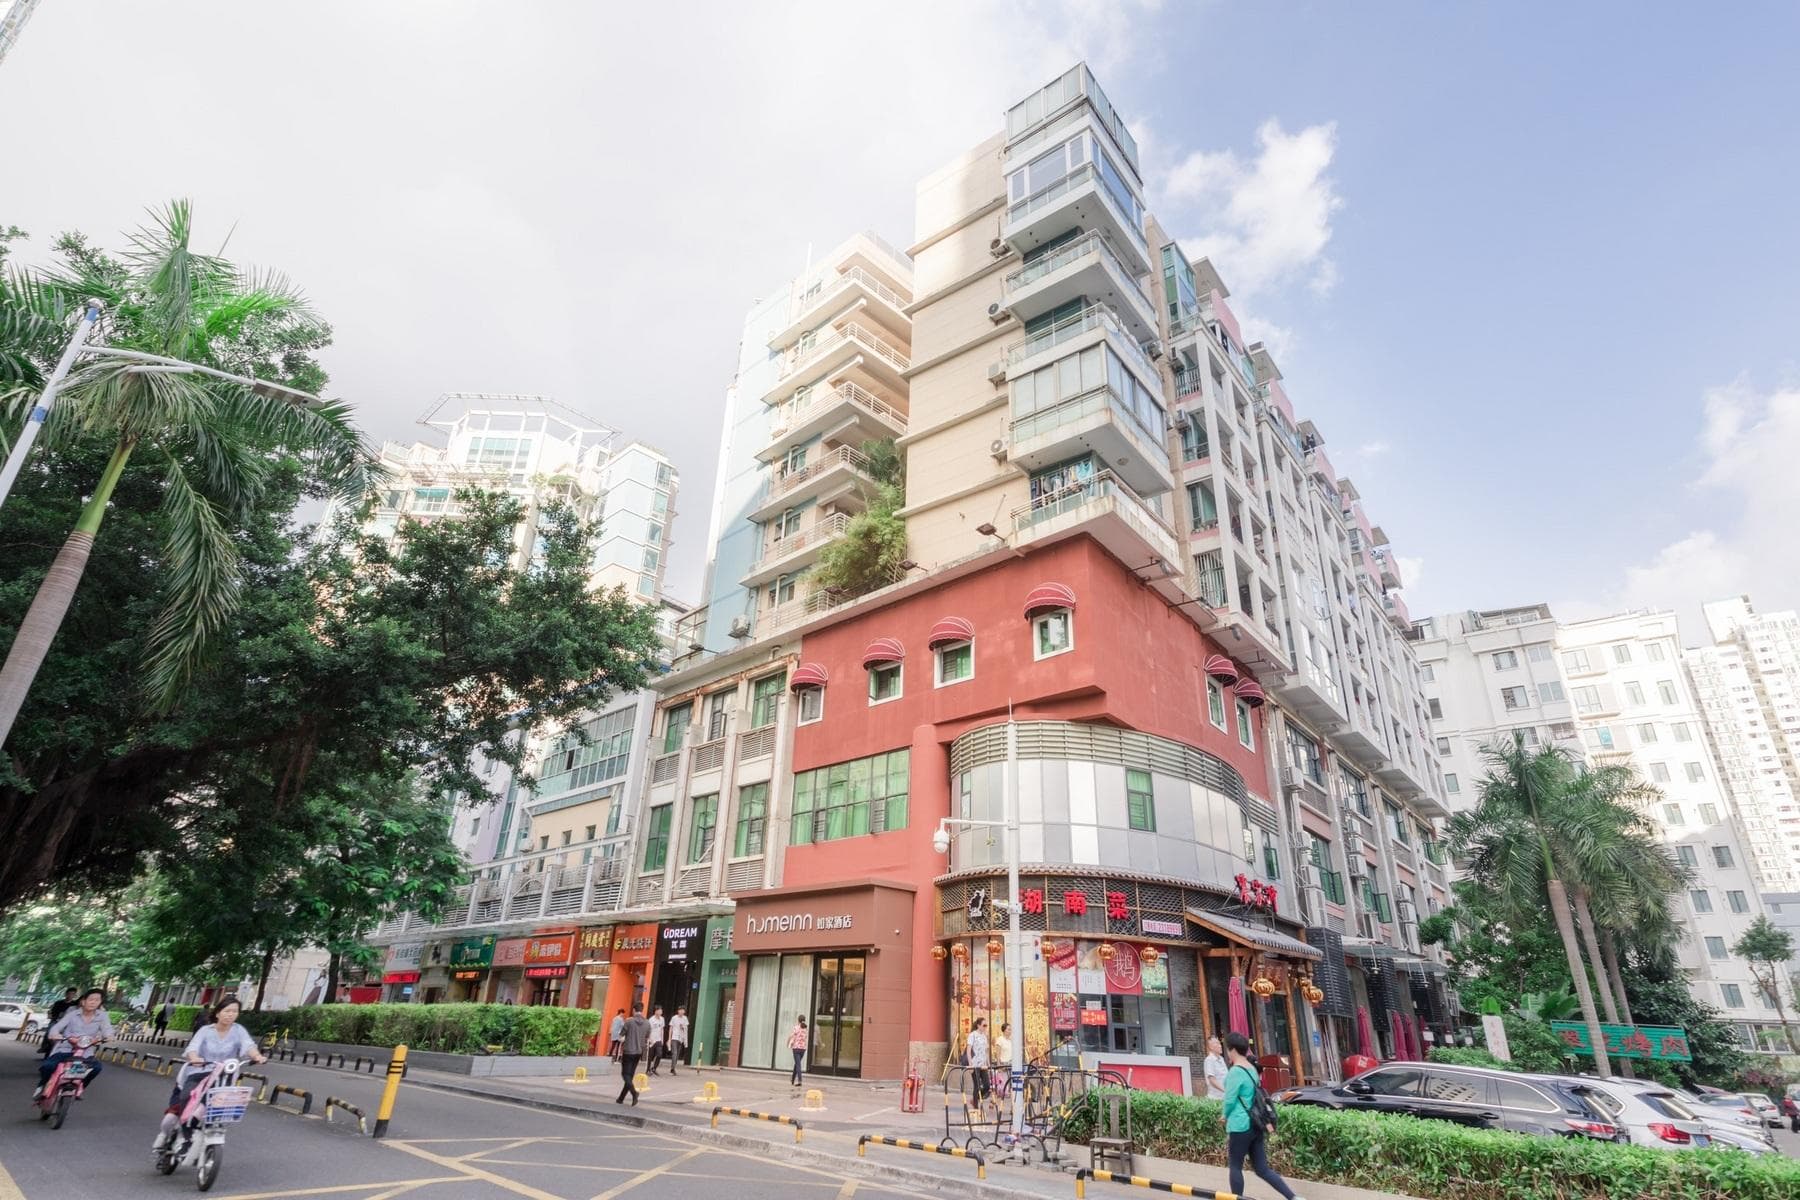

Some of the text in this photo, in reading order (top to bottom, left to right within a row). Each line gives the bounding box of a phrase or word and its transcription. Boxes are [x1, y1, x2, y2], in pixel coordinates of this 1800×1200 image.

[1020, 888, 1130, 920] 湖南菜
[816, 914, 853, 931] 如家酒店
